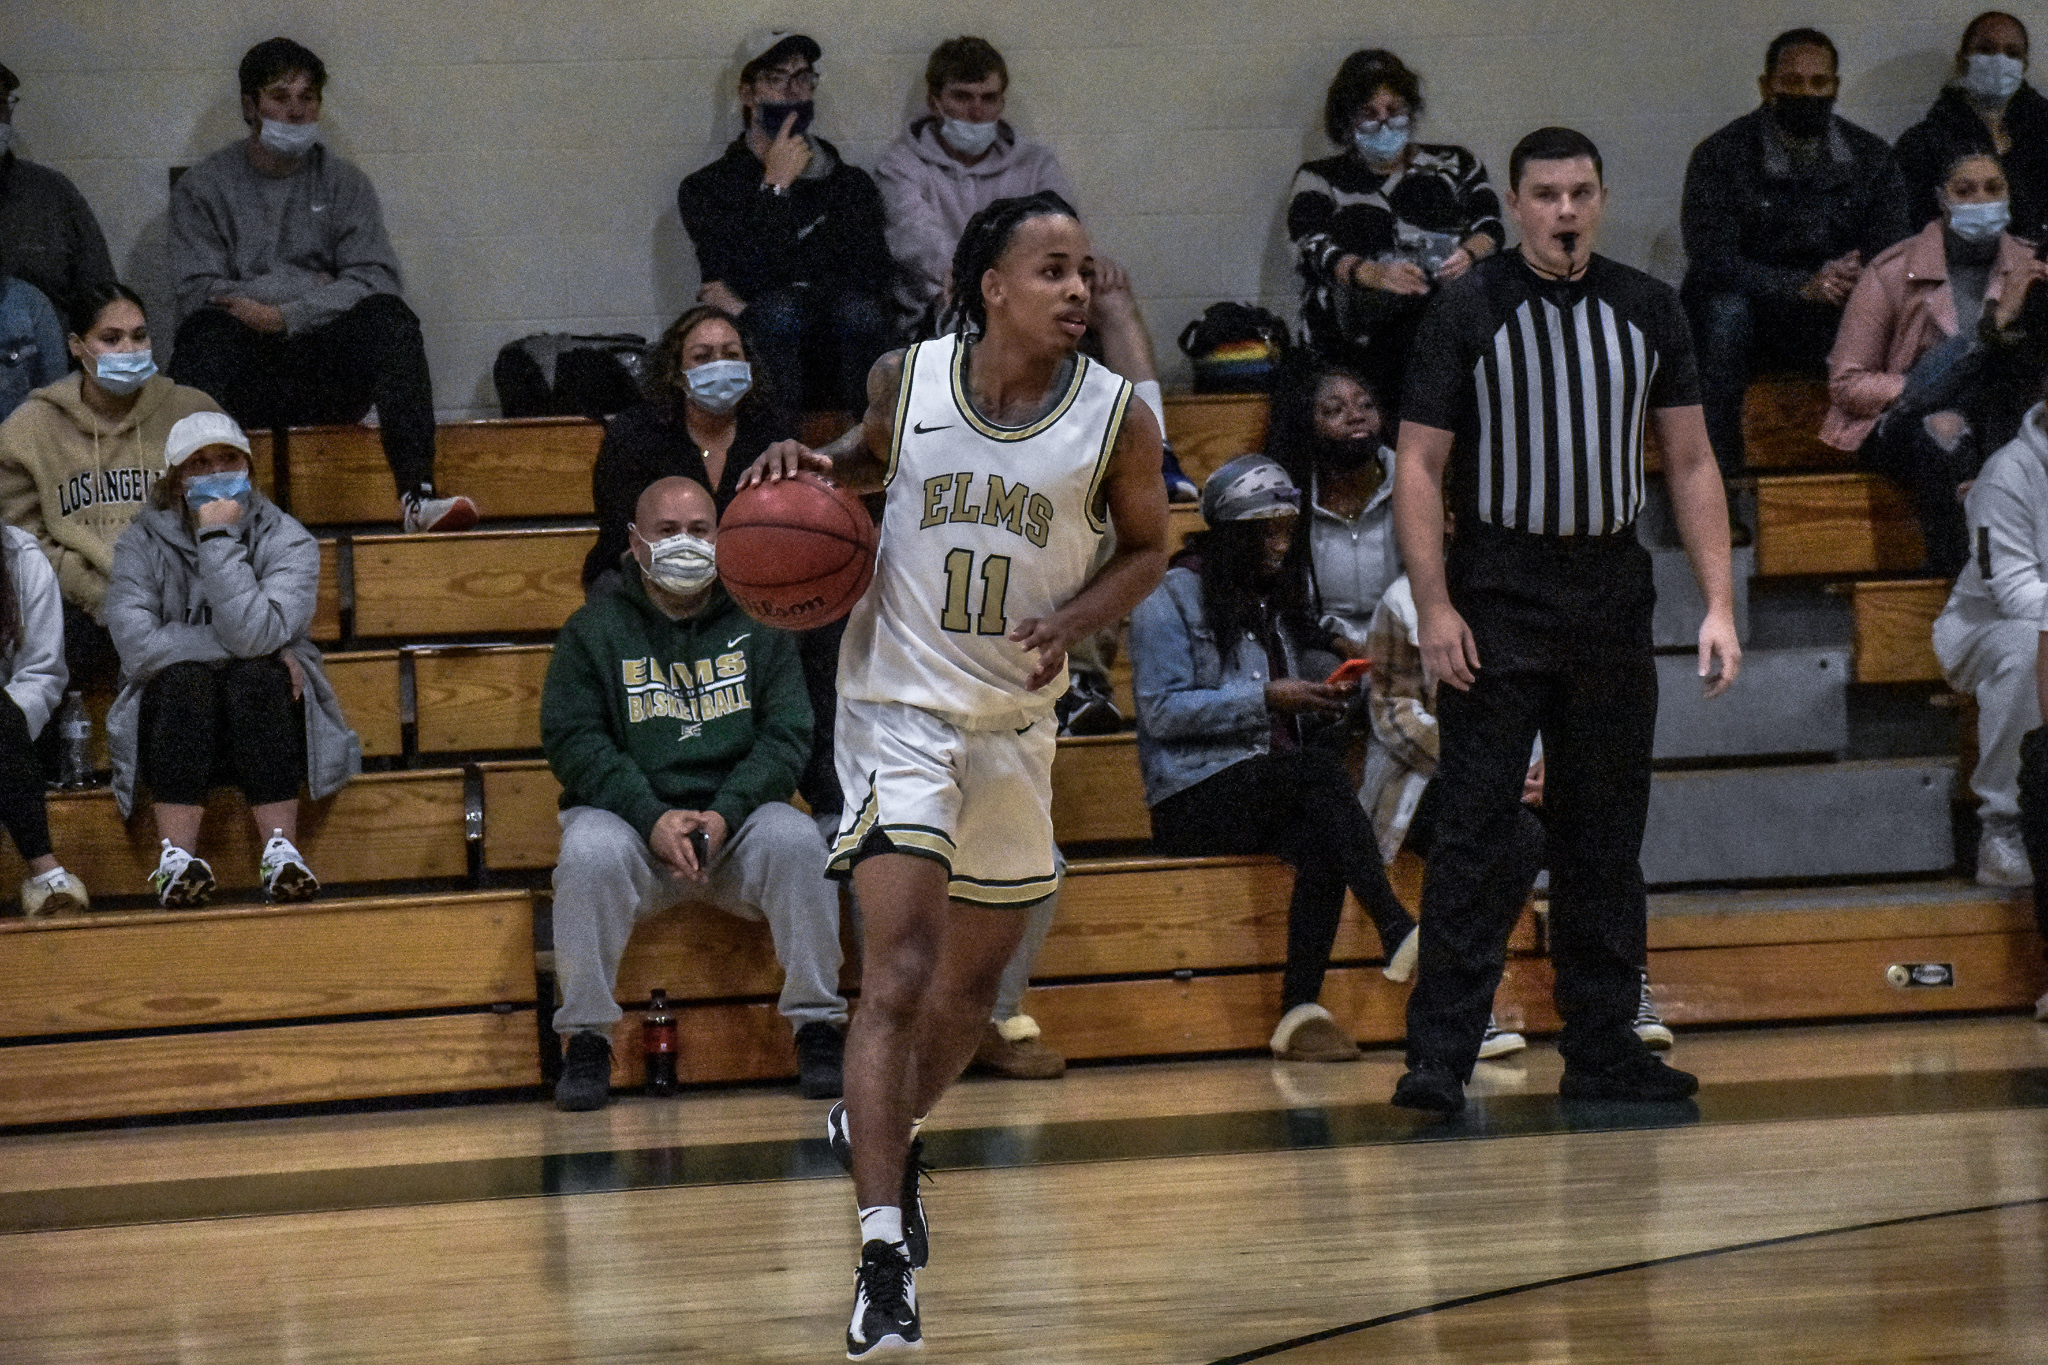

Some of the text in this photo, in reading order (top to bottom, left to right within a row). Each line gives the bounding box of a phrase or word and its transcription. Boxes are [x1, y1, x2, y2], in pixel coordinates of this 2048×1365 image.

[58, 471, 92, 517] LOS
[920, 472, 1054, 549] ELMS
[941, 547, 1011, 636] 11
[622, 650, 747, 690] ELMS
[628, 683, 752, 723] BASKETBALL
